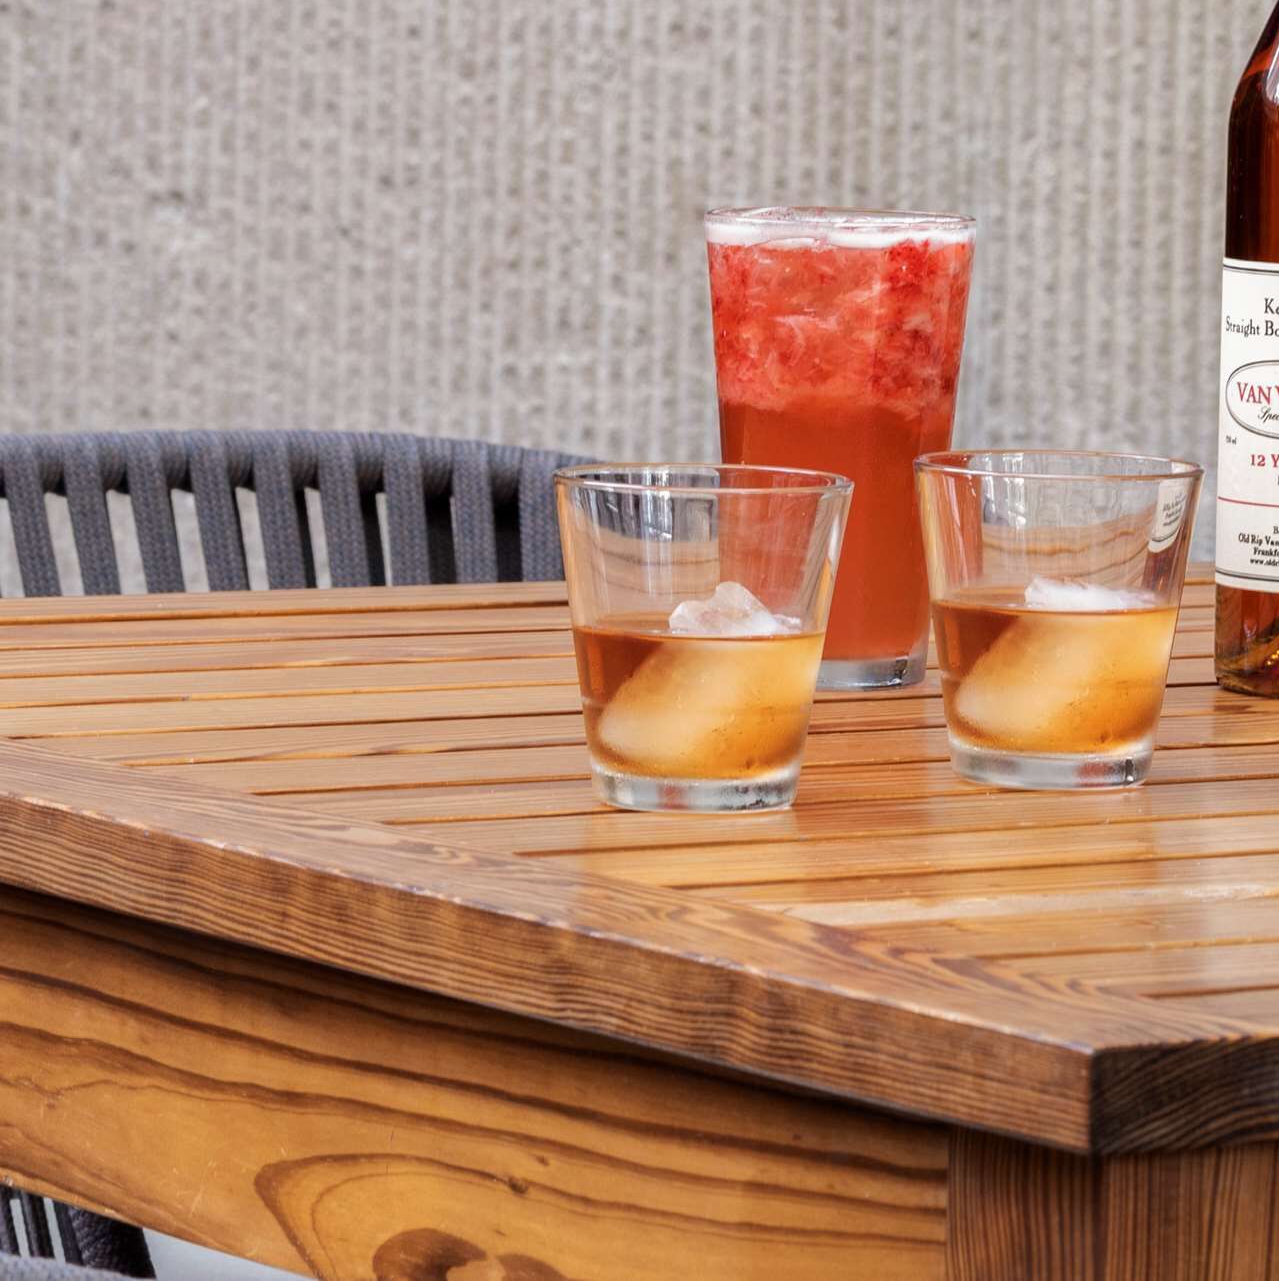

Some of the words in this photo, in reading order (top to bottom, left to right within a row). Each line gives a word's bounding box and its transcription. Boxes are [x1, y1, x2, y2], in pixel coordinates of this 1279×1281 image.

[1225, 316, 1260, 338] Straight
[1237, 381, 1272, 405] VAN
[1250, 454, 1266, 467] 12
[1238, 533, 1250, 544] Old
[1251, 534, 1263, 546] Rip
[1265, 536, 1279, 546] Van
